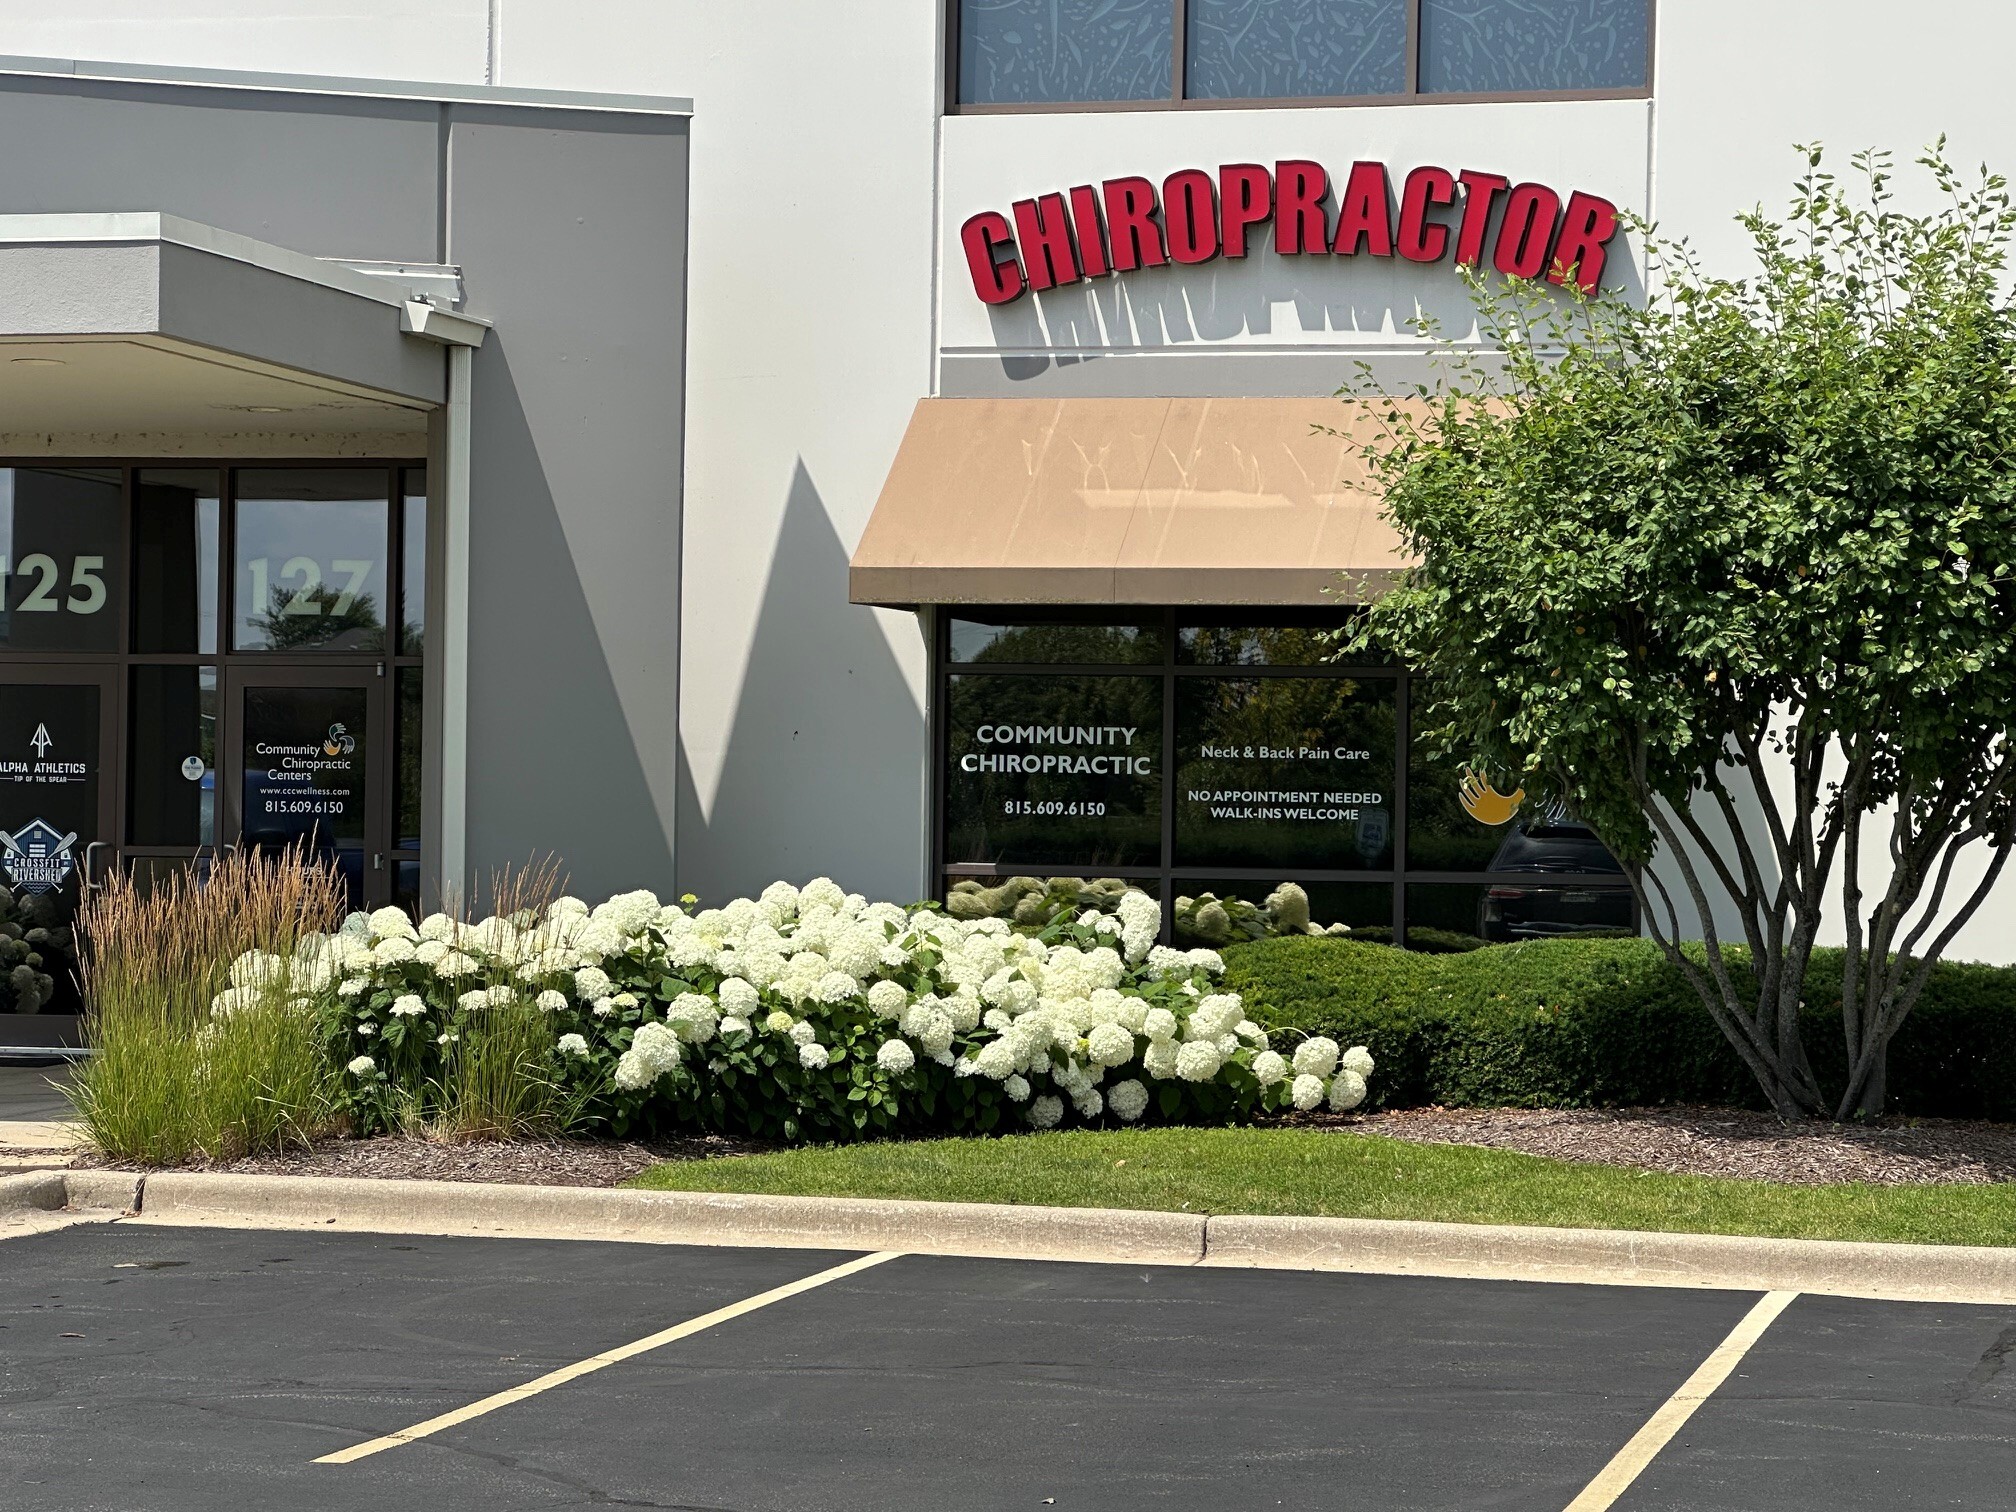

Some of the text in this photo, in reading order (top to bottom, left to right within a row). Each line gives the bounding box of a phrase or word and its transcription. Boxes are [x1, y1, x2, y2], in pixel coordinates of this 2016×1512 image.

[960, 159, 1620, 305] CHIROPRACTOR
[248, 556, 374, 617] 127
[976, 725, 1137, 746] COMMUNITY
[256, 742, 321, 758] Community
[1201, 746, 1370, 760] Neck & Back Pain Care
[34, 762, 86, 774] ATHLETICS
[282, 757, 351, 772] Chiropractic
[960, 753, 1151, 775] CHIROPRACTIC
[267, 769, 312, 781] Centers
[260, 786, 350, 796] www.cccwellness.com
[1188, 790, 1382, 804] NO APPOINTMENT NEEDED
[265, 800, 344, 813] 815.609.6150
[1004, 800, 1106, 816] 815.609.6150
[1210, 807, 1359, 820] WALK-INS WELCOME
[13, 857, 61, 868] CROSSFIT
[13, 868, 61, 881] RIVERSHED
